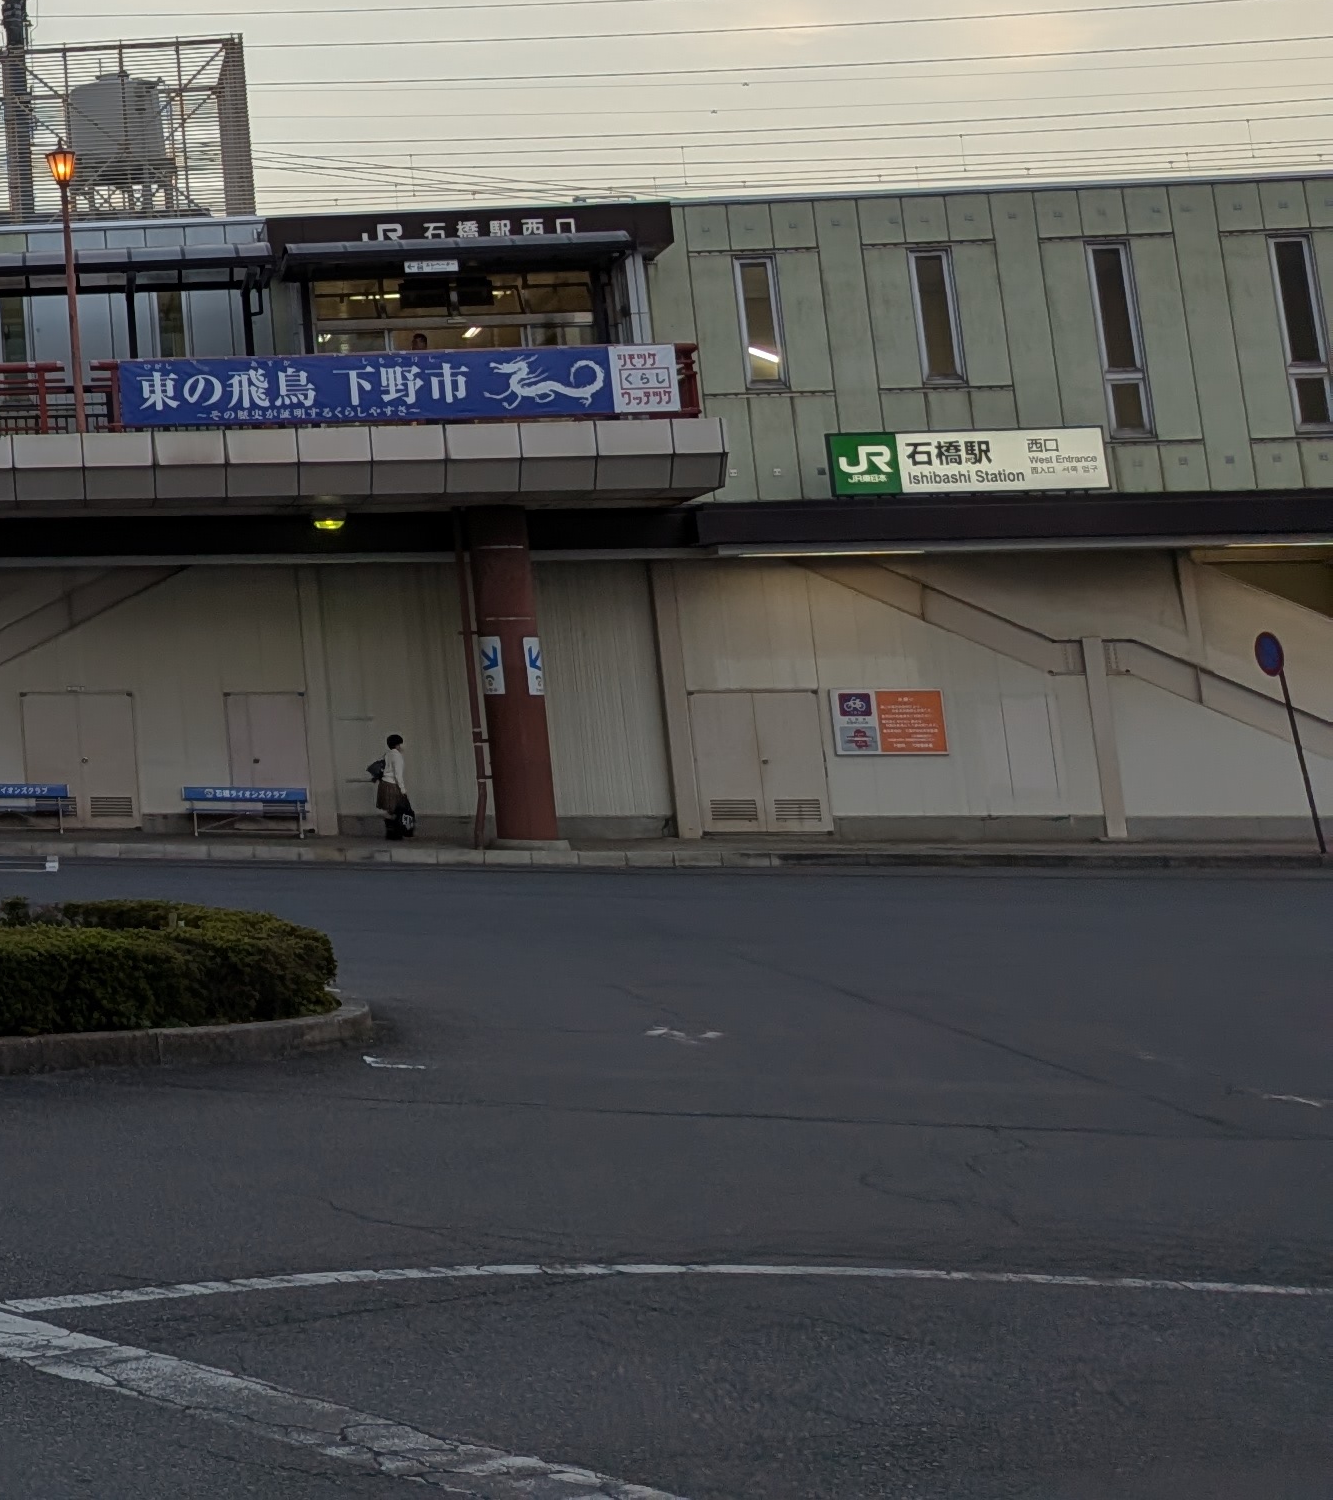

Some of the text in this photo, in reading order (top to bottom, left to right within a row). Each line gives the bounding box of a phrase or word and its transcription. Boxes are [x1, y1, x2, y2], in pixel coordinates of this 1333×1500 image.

[136, 362, 469, 410] 東の飛鳥 下野市
[625, 373, 665, 385] くらし
[905, 440, 993, 467] 石橋駅
[1026, 438, 1059, 453] 西口
[838, 445, 893, 473] JR
[1028, 455, 1097, 464] West Entrance
[908, 468, 1025, 485] Ishibashi Station
